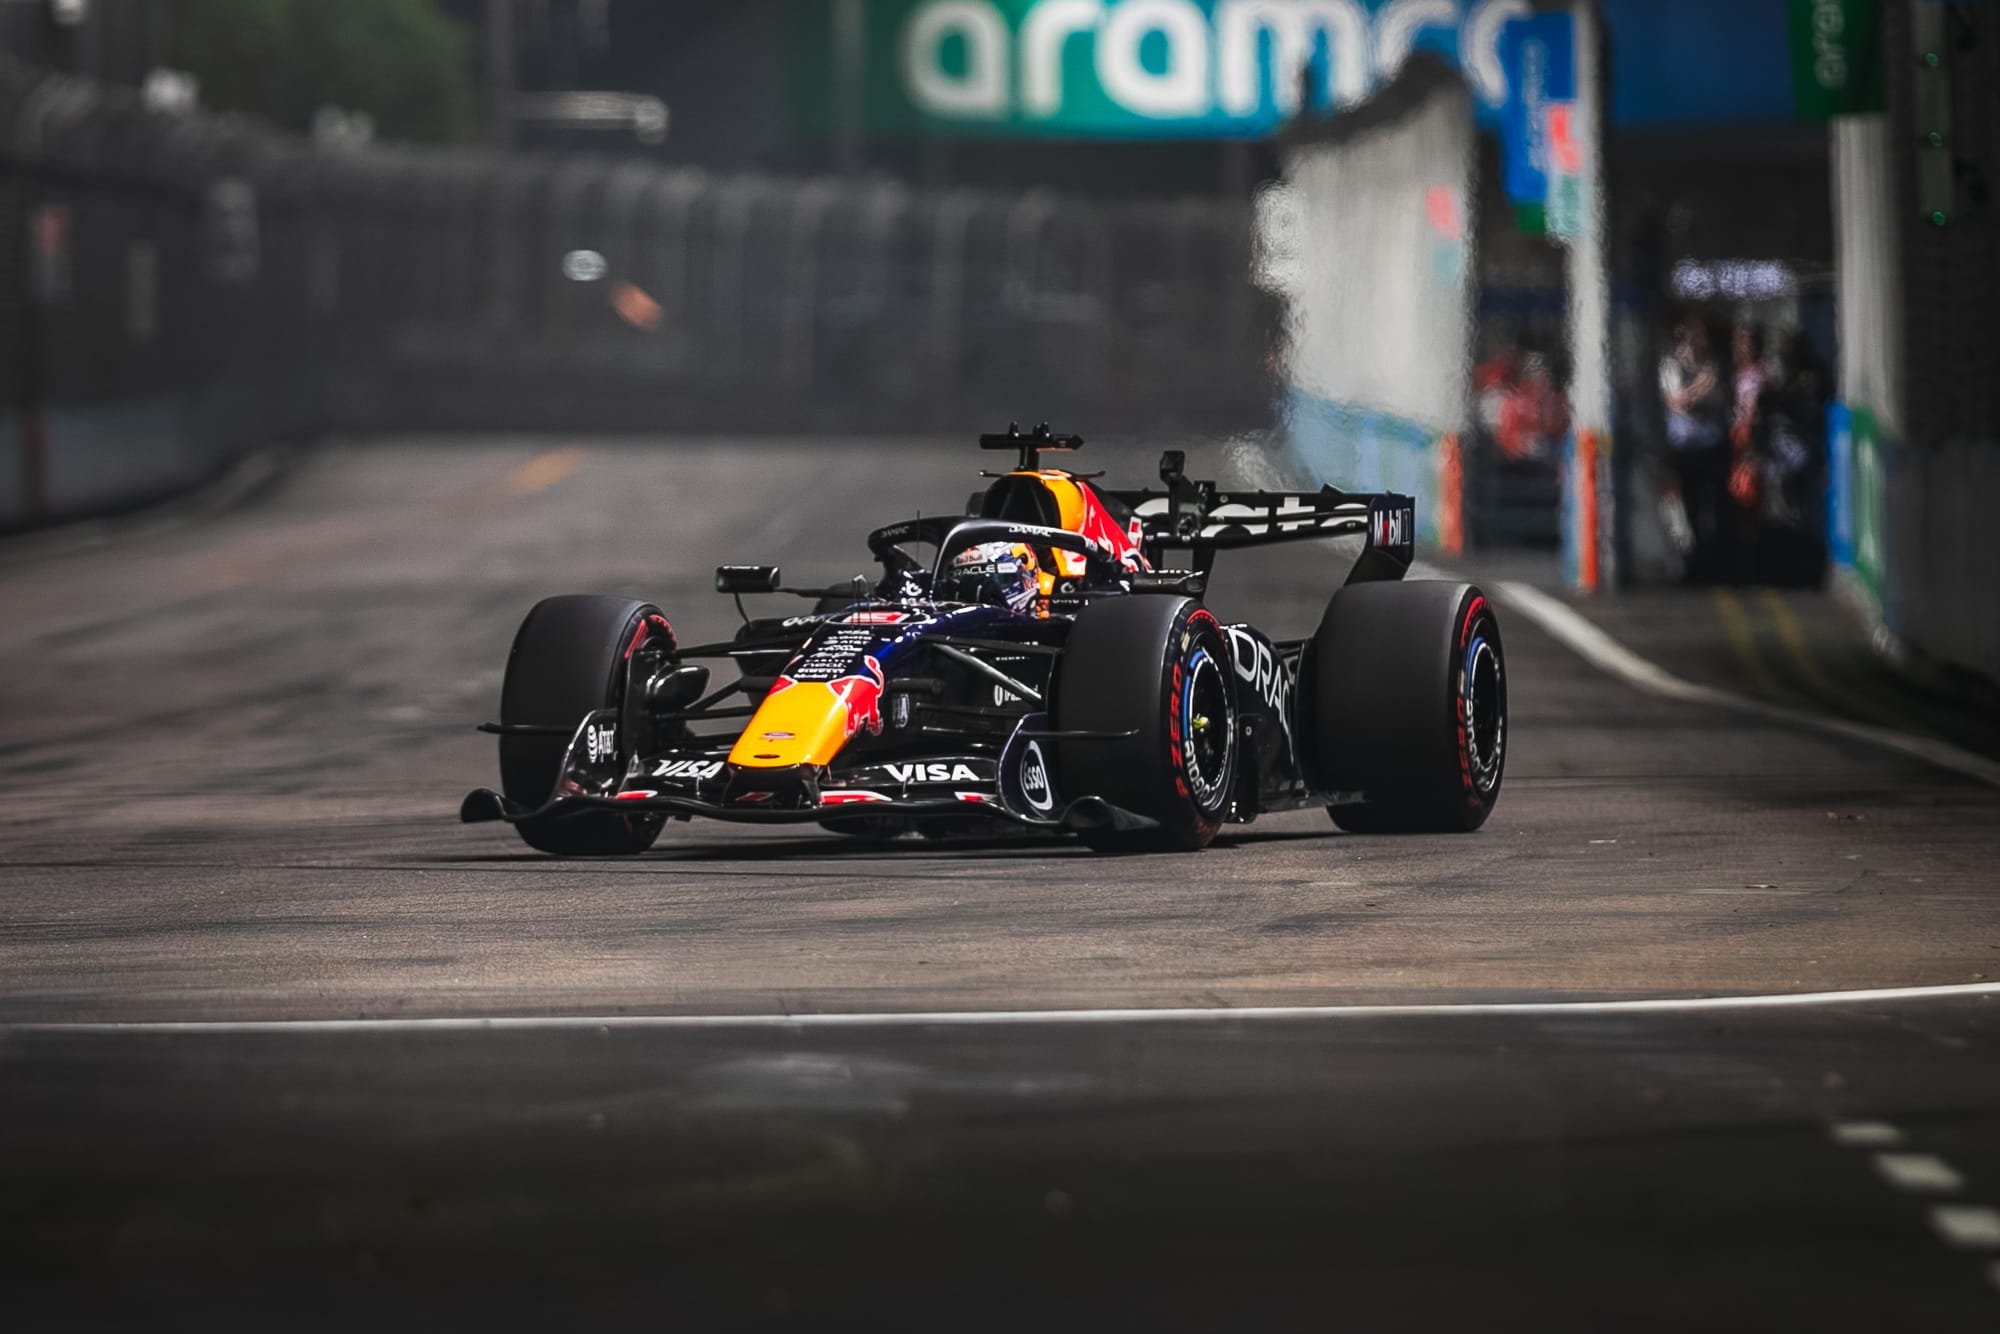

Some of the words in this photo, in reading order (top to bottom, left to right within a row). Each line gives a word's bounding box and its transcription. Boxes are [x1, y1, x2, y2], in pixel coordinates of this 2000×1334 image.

[1373, 509, 1402, 546] Mobil
[951, 564, 996, 576] RACLE
[1169, 662, 1183, 768] ZERO
[652, 759, 725, 779] VISA
[883, 764, 980, 782] VISA
